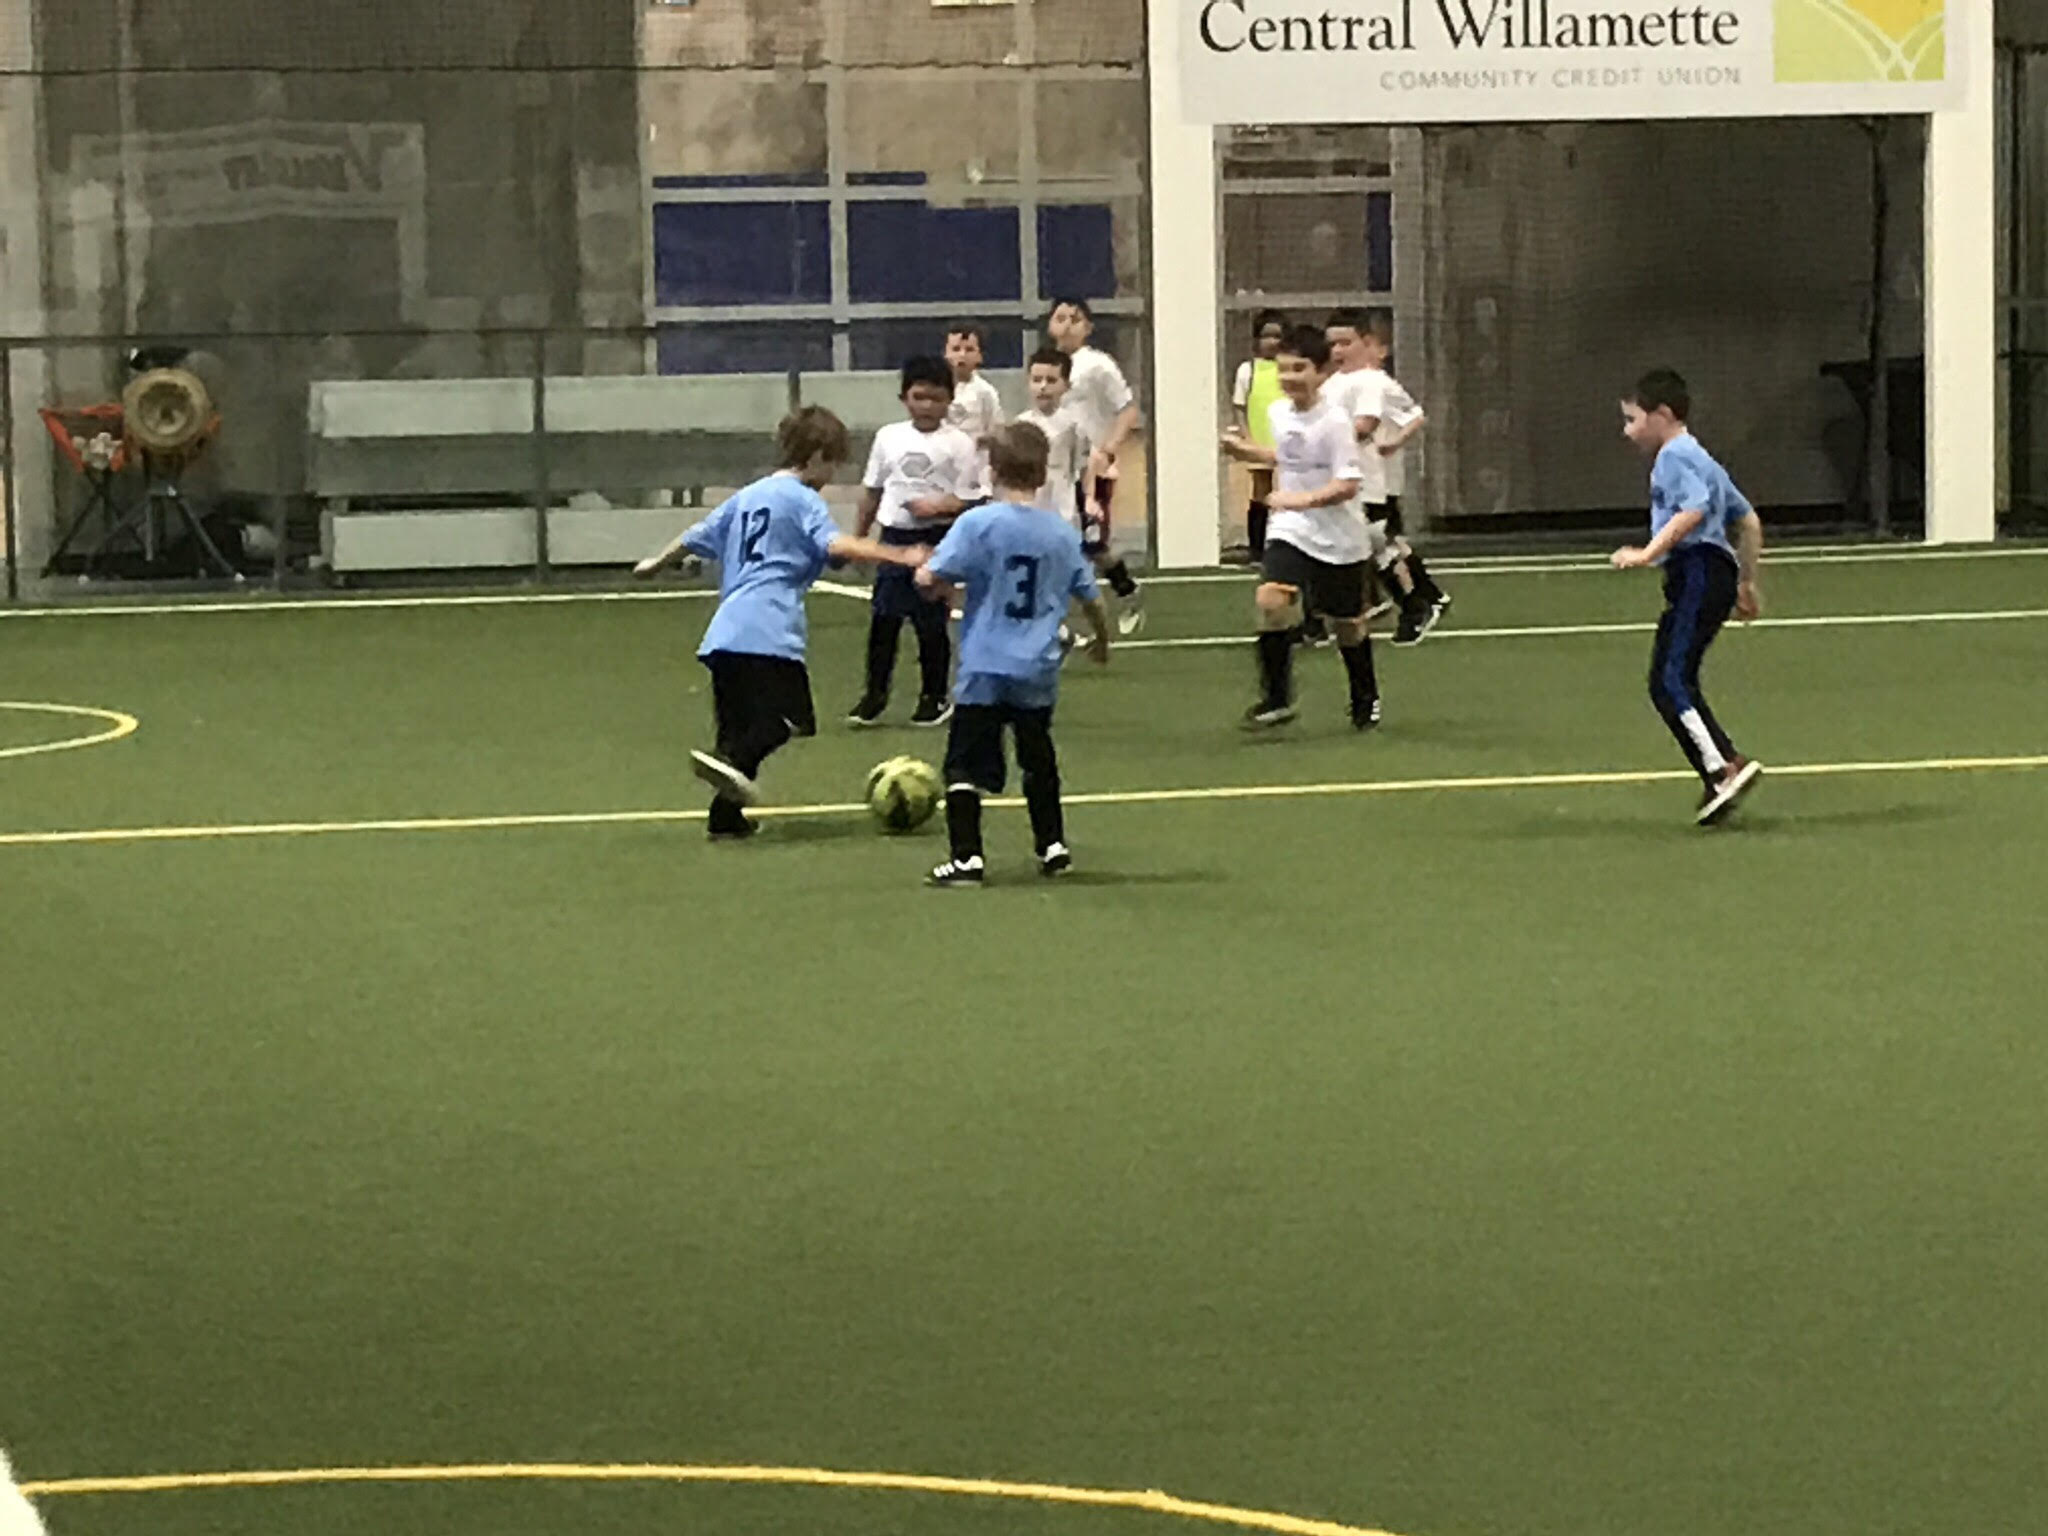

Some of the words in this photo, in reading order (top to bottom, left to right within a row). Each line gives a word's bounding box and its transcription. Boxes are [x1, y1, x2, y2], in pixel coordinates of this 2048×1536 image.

[1199, 0, 1416, 52] Central
[1431, 0, 1740, 49] Willamette
[1380, 69, 1538, 91] COMMUNITY
[1551, 66, 1642, 88] CREDIT
[1656, 65, 1742, 86] UNION
[738, 507, 771, 567] 12
[1004, 555, 1039, 620] 3
